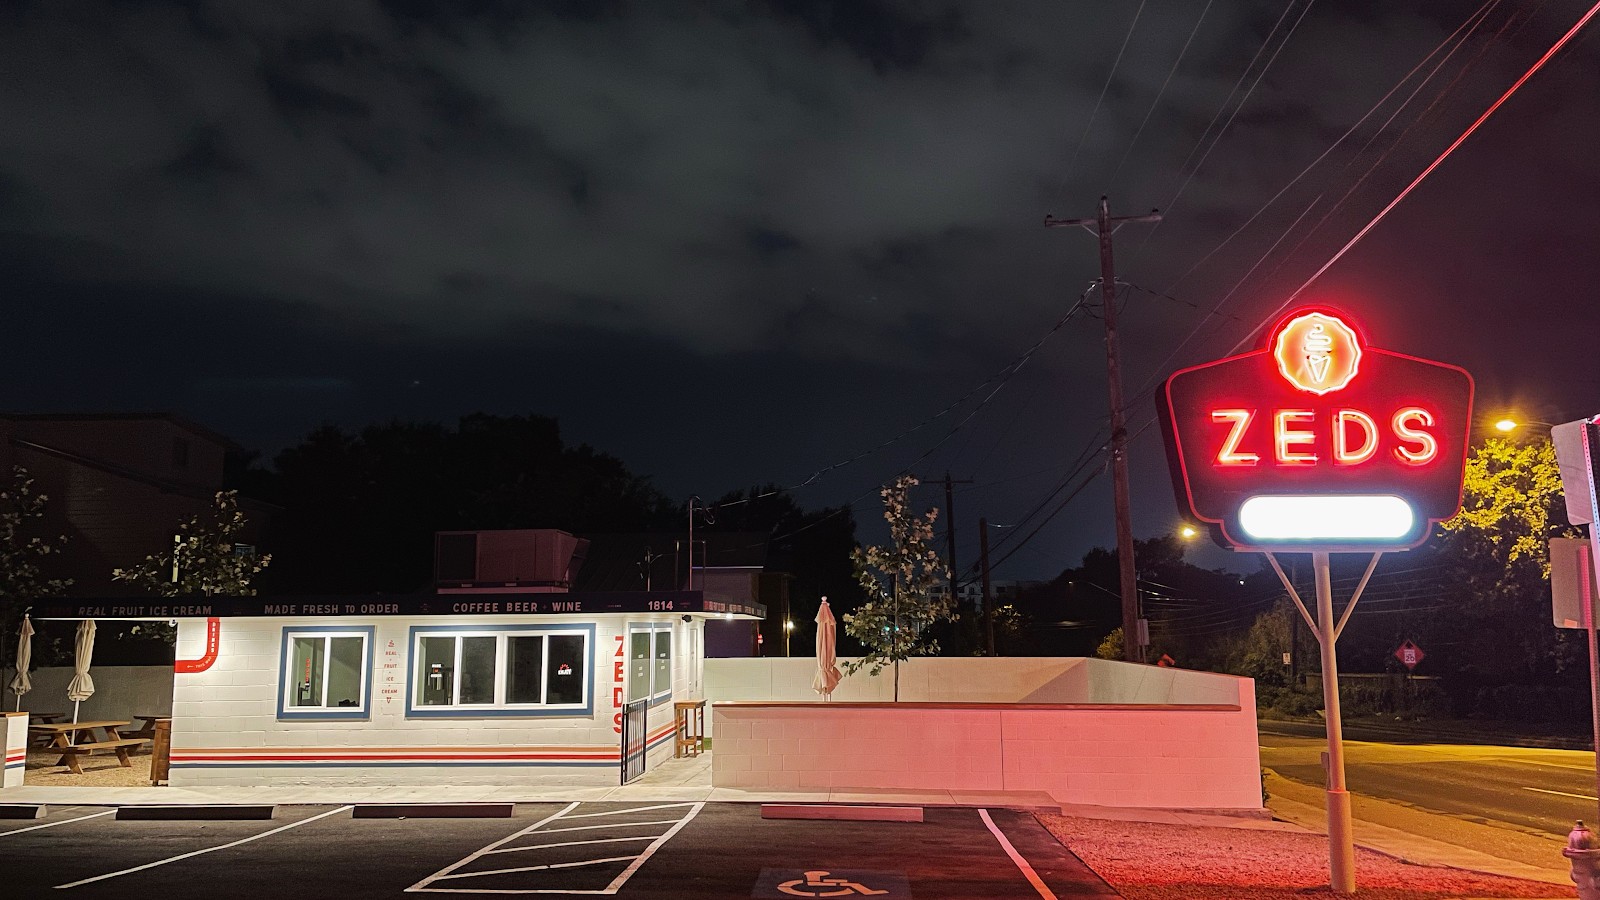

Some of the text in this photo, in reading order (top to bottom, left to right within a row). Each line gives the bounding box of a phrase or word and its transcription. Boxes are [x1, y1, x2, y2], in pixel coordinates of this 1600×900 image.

[1211, 407, 1438, 466] ZEDS
[78, 606, 107, 616] REAL
[112, 606, 145, 616] FRUIT
[149, 605, 168, 616] ICE
[172, 605, 212, 616] CREAM
[264, 603, 399, 615] MADE FRESH TO ORDER
[453, 602, 499, 613] COFFEE
[506, 602, 538, 612] BEER
[552, 601, 582, 612] WINE
[648, 600, 674, 611] 1814
[613, 635, 624, 734] ZEDS
